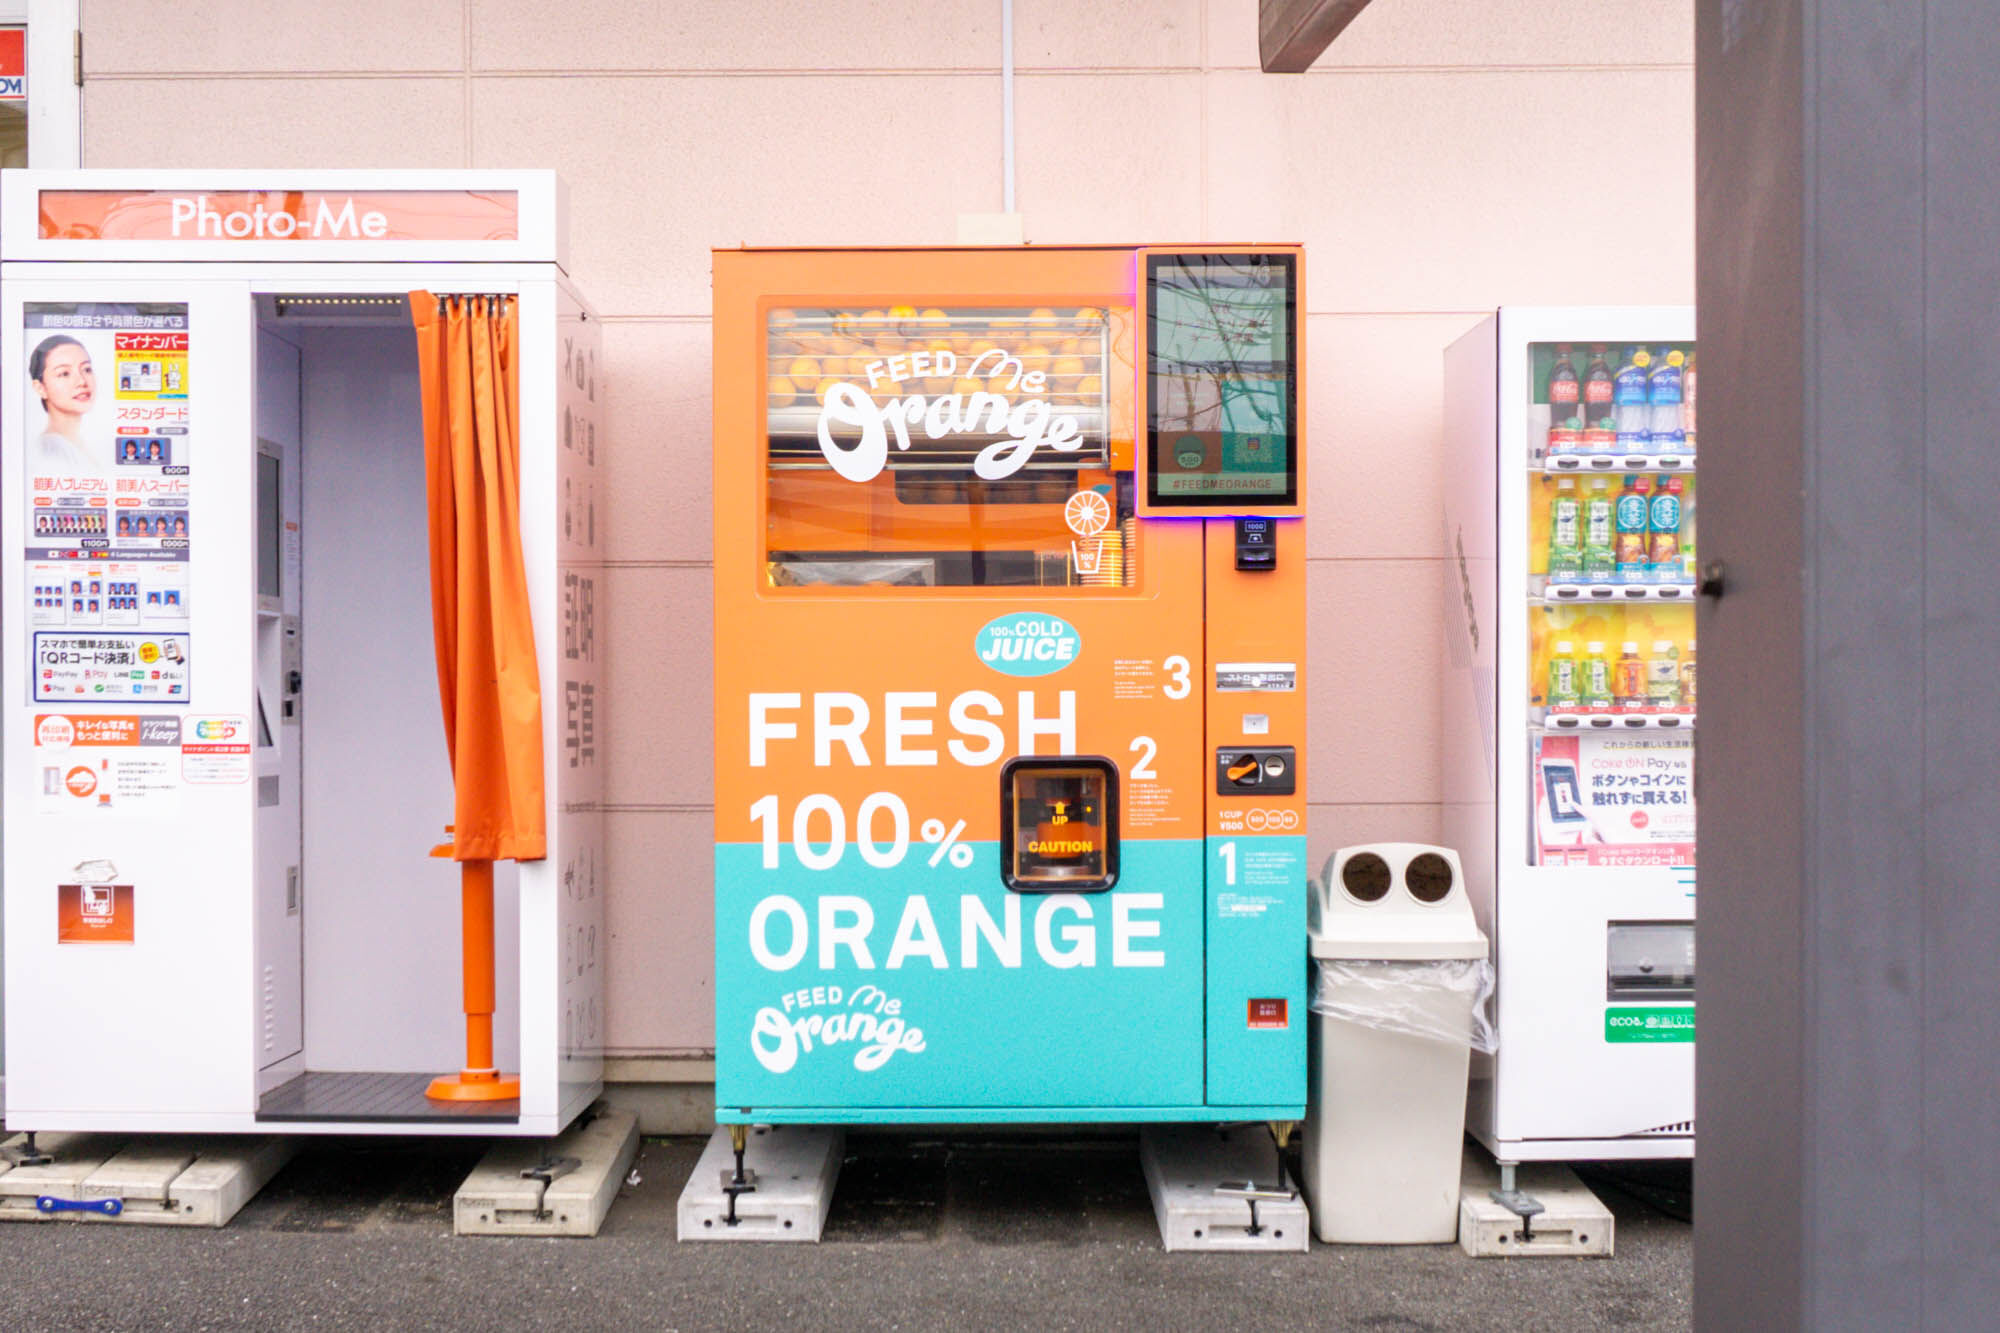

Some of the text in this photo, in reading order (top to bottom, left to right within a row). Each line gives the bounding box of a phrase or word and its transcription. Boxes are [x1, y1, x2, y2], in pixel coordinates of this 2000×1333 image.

[171, 198, 388, 238] Photo-Me
[116, 335, 188, 349] マイナンバー
[864, 349, 1047, 394] FEED Me
[117, 407, 189, 421] スタンダード
[817, 382, 1084, 482] Orange
[116, 479, 189, 493] 肌美人スーパー
[1172, 479, 1272, 489] #FEEDMEORANGE
[1080, 552, 1095, 561] 100
[1016, 621, 1064, 637] COLD
[40, 639, 136, 649] スマホで簡単お支払い
[982, 638, 1075, 661] JUICE
[40, 651, 136, 665] 「QRコード決済」
[1163, 655, 1191, 700] 3
[748, 690, 1077, 767] FRESH
[1602, 740, 1694, 749] これからの新しい生活様
[1129, 735, 1157, 780] 2
[1592, 757, 1623, 769] Coke
[1647, 757, 1672, 771] Pay
[1592, 774, 1687, 787] ボタンやコインに
[1052, 815, 1069, 826] UP
[748, 791, 975, 872] 100%
[1028, 841, 1093, 853] CAUTION
[1218, 841, 1236, 886] 1
[748, 893, 1166, 972] ORANGE
[782, 985, 903, 1015] FEED Me
[751, 1006, 927, 1074] Orange
